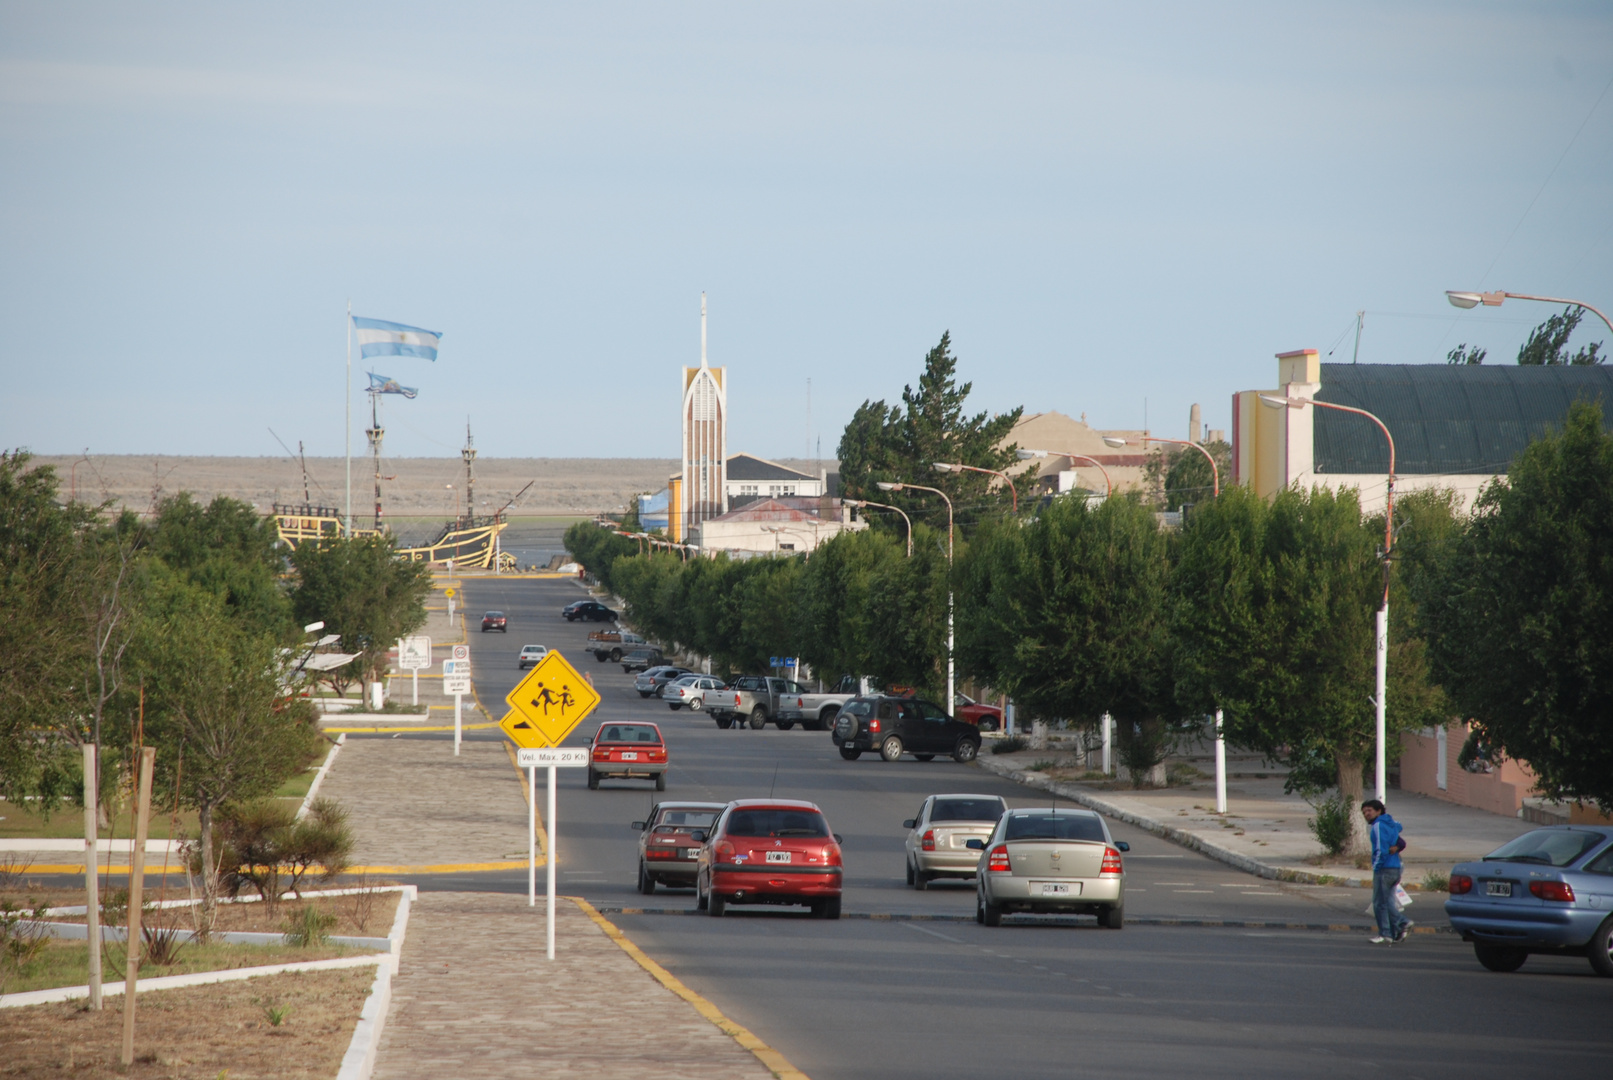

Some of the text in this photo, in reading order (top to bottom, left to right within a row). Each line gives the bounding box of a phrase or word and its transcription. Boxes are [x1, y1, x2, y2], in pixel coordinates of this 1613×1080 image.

[522, 753, 535, 761] Vel.
[539, 753, 558, 761] Max.
[561, 753, 572, 761] 20
